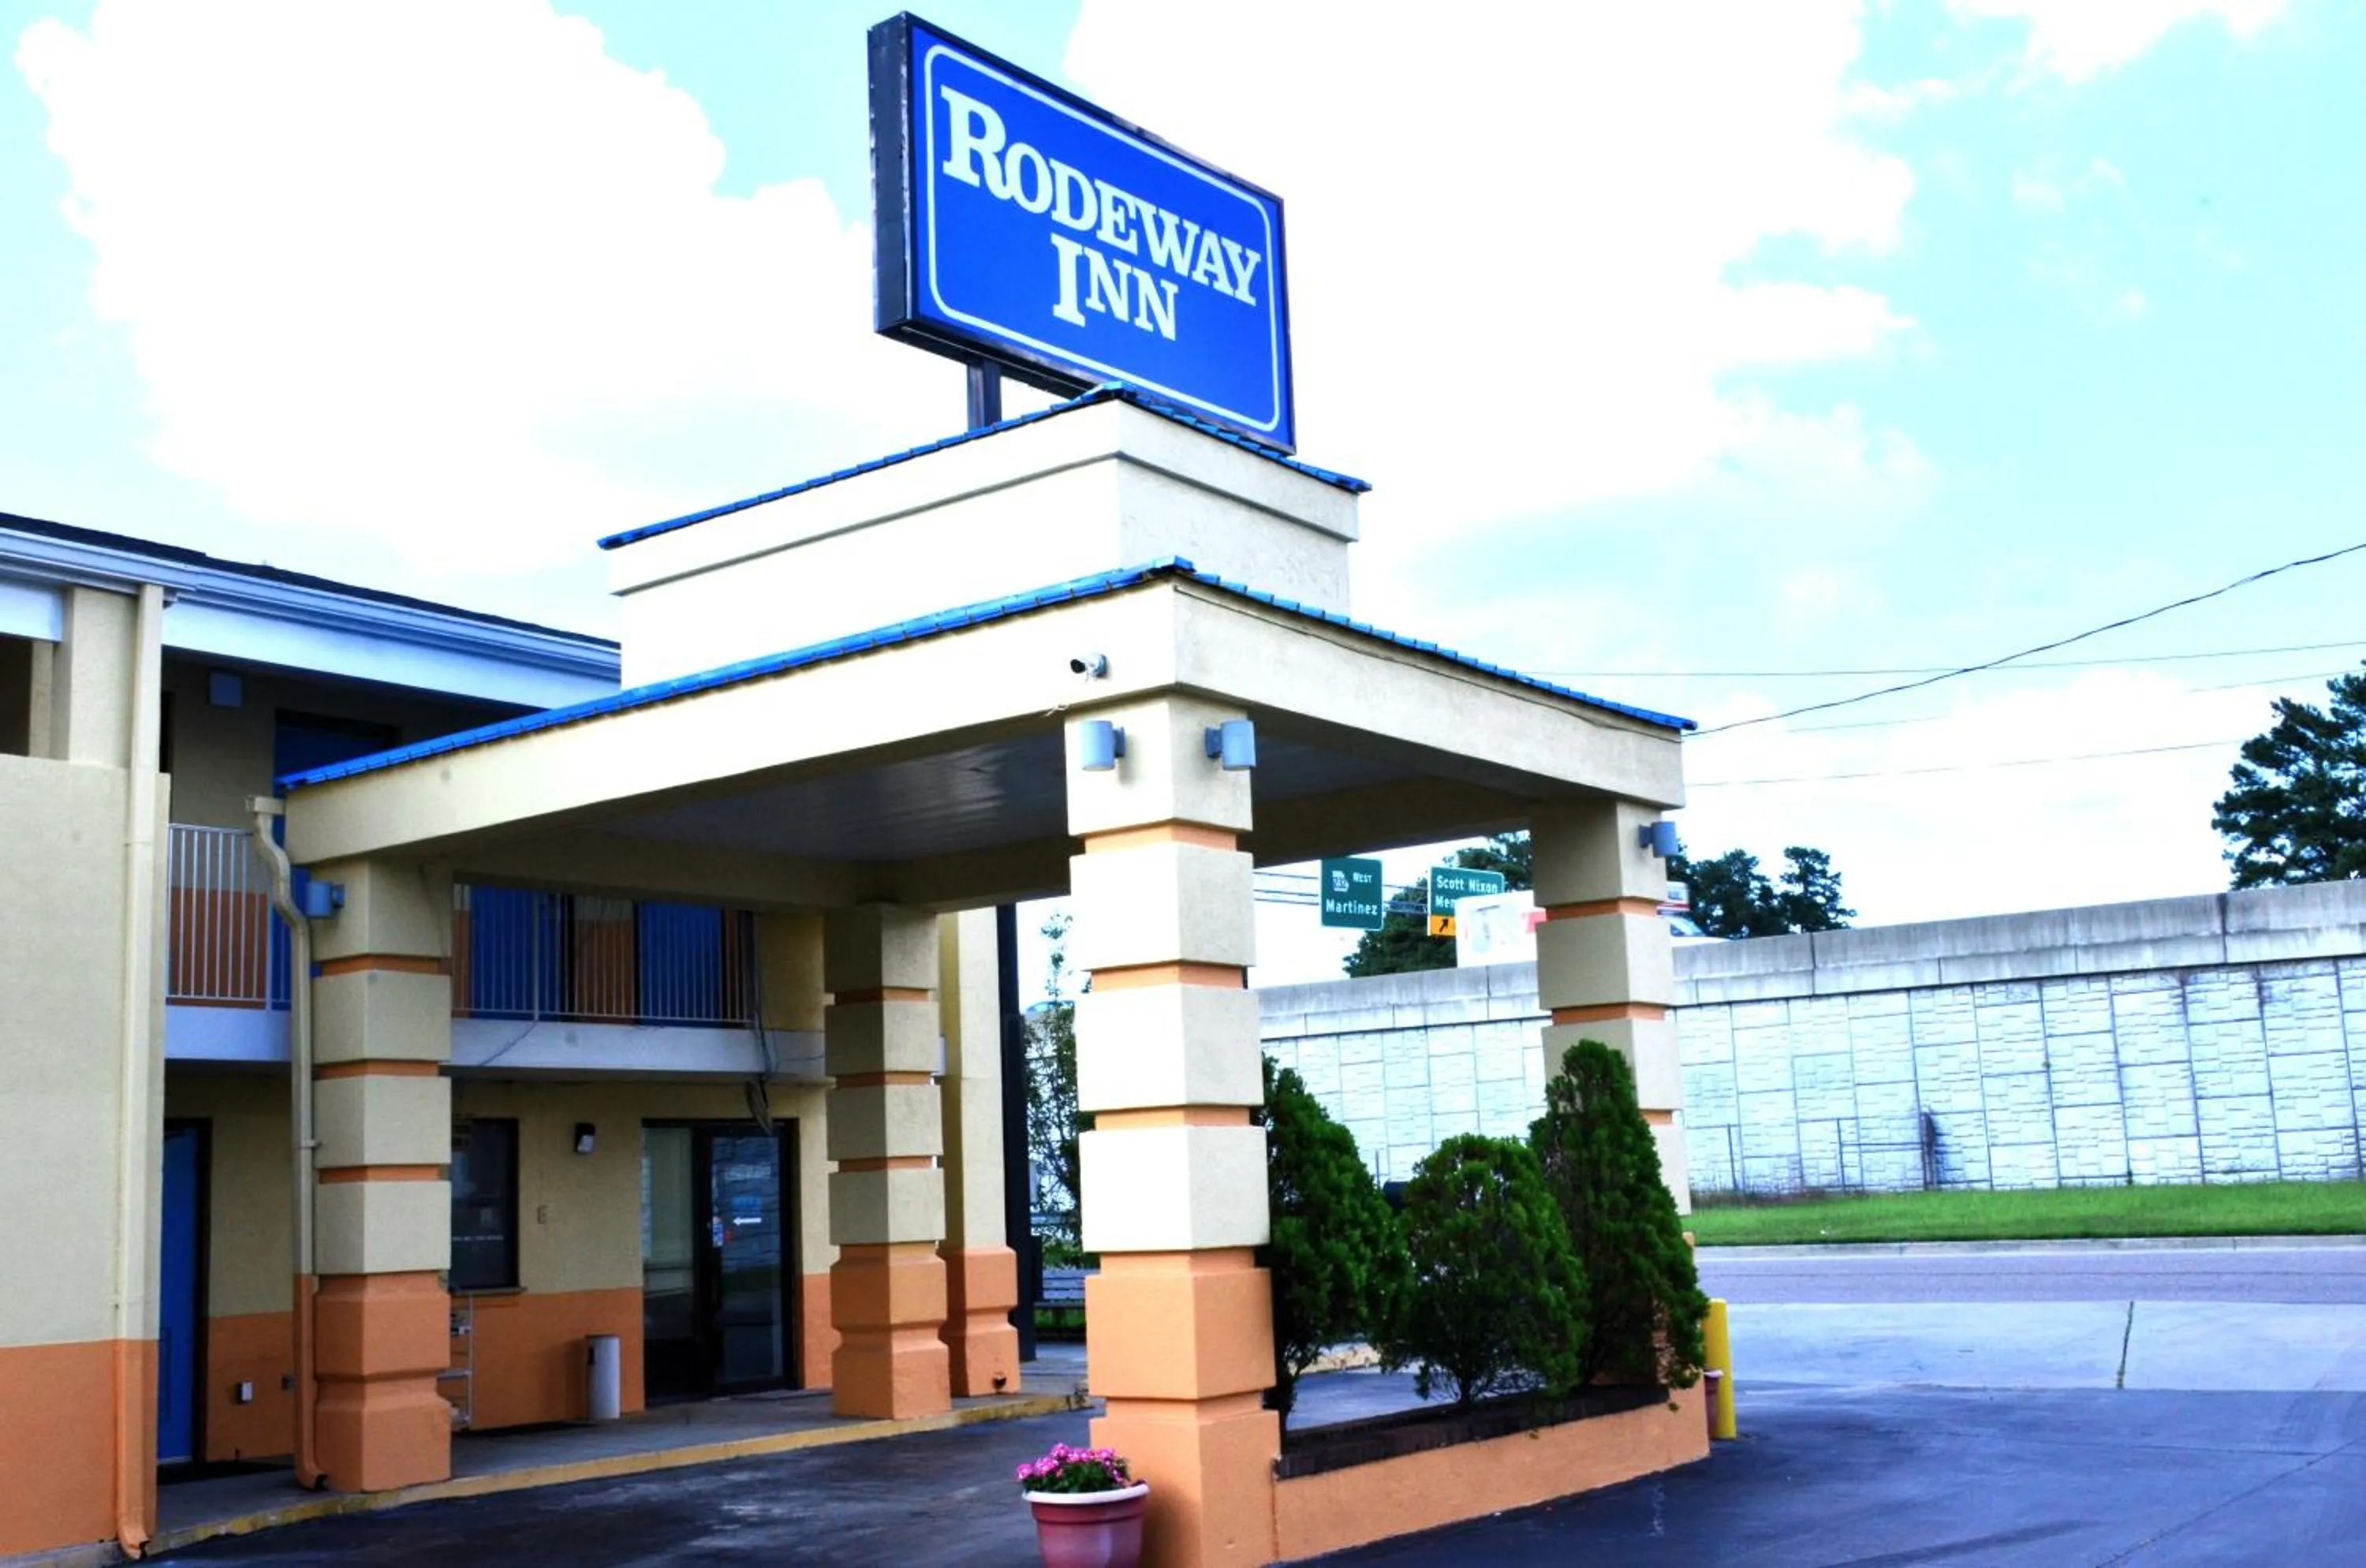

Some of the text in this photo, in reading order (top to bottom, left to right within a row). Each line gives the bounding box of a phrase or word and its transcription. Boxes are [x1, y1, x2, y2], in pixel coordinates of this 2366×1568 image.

[940, 84, 1261, 306] RODEWAY
[1051, 233, 1179, 341] INN
[1326, 898, 1379, 916] Martinez
[1436, 875, 1498, 894] Scott Nixon
